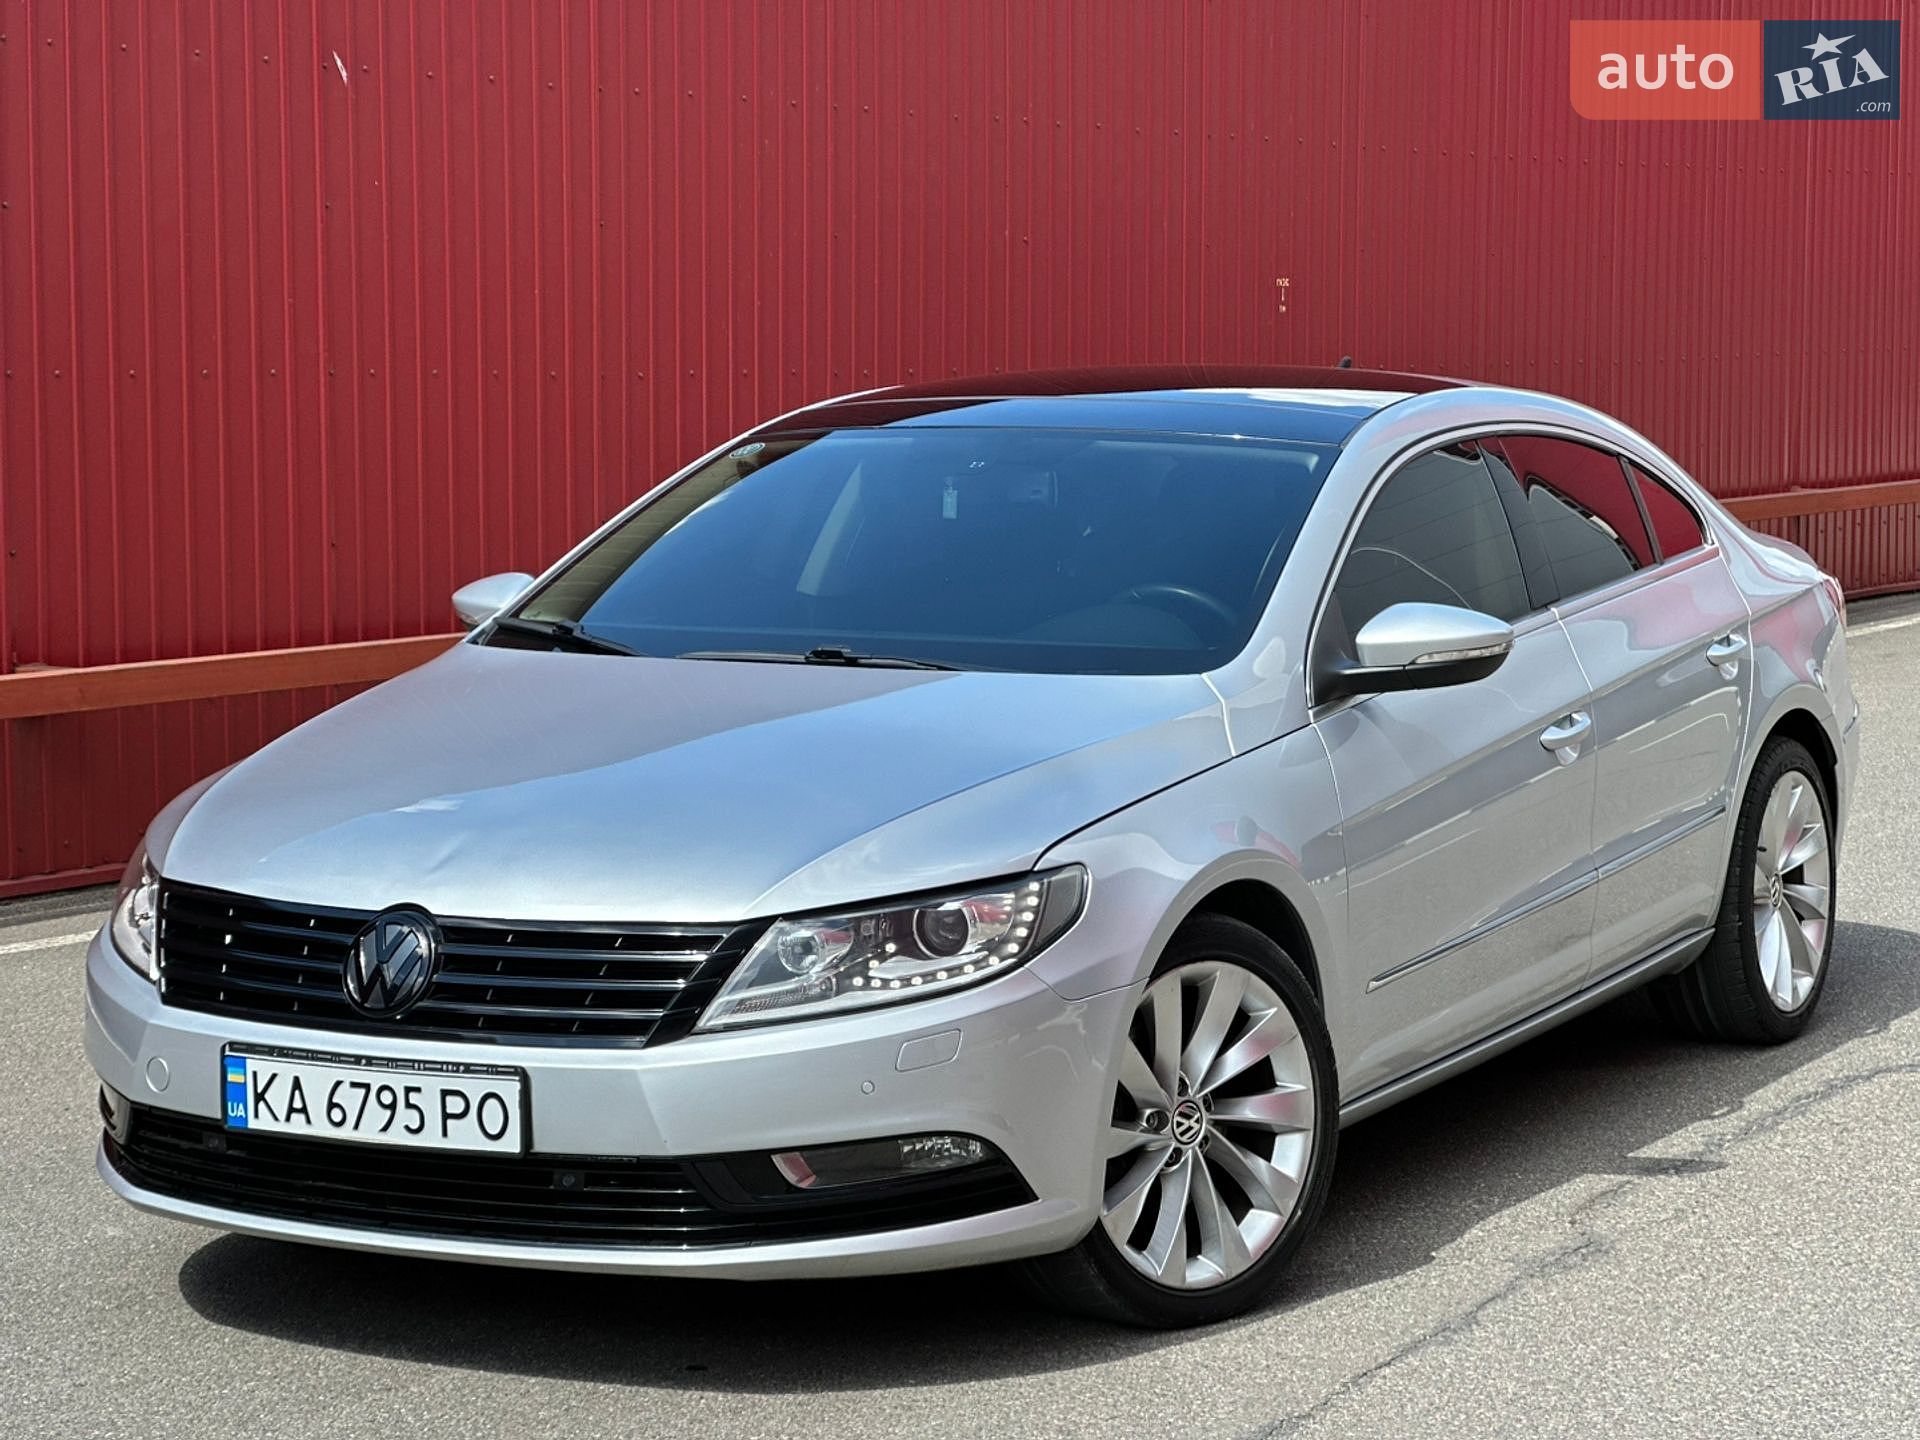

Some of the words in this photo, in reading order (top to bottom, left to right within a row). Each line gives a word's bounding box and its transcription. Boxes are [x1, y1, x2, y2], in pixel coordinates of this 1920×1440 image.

[227, 1104, 246, 1119] UA
[252, 1070, 312, 1125] KA
[325, 1079, 426, 1135] 6795
[440, 1088, 509, 1141] PO
